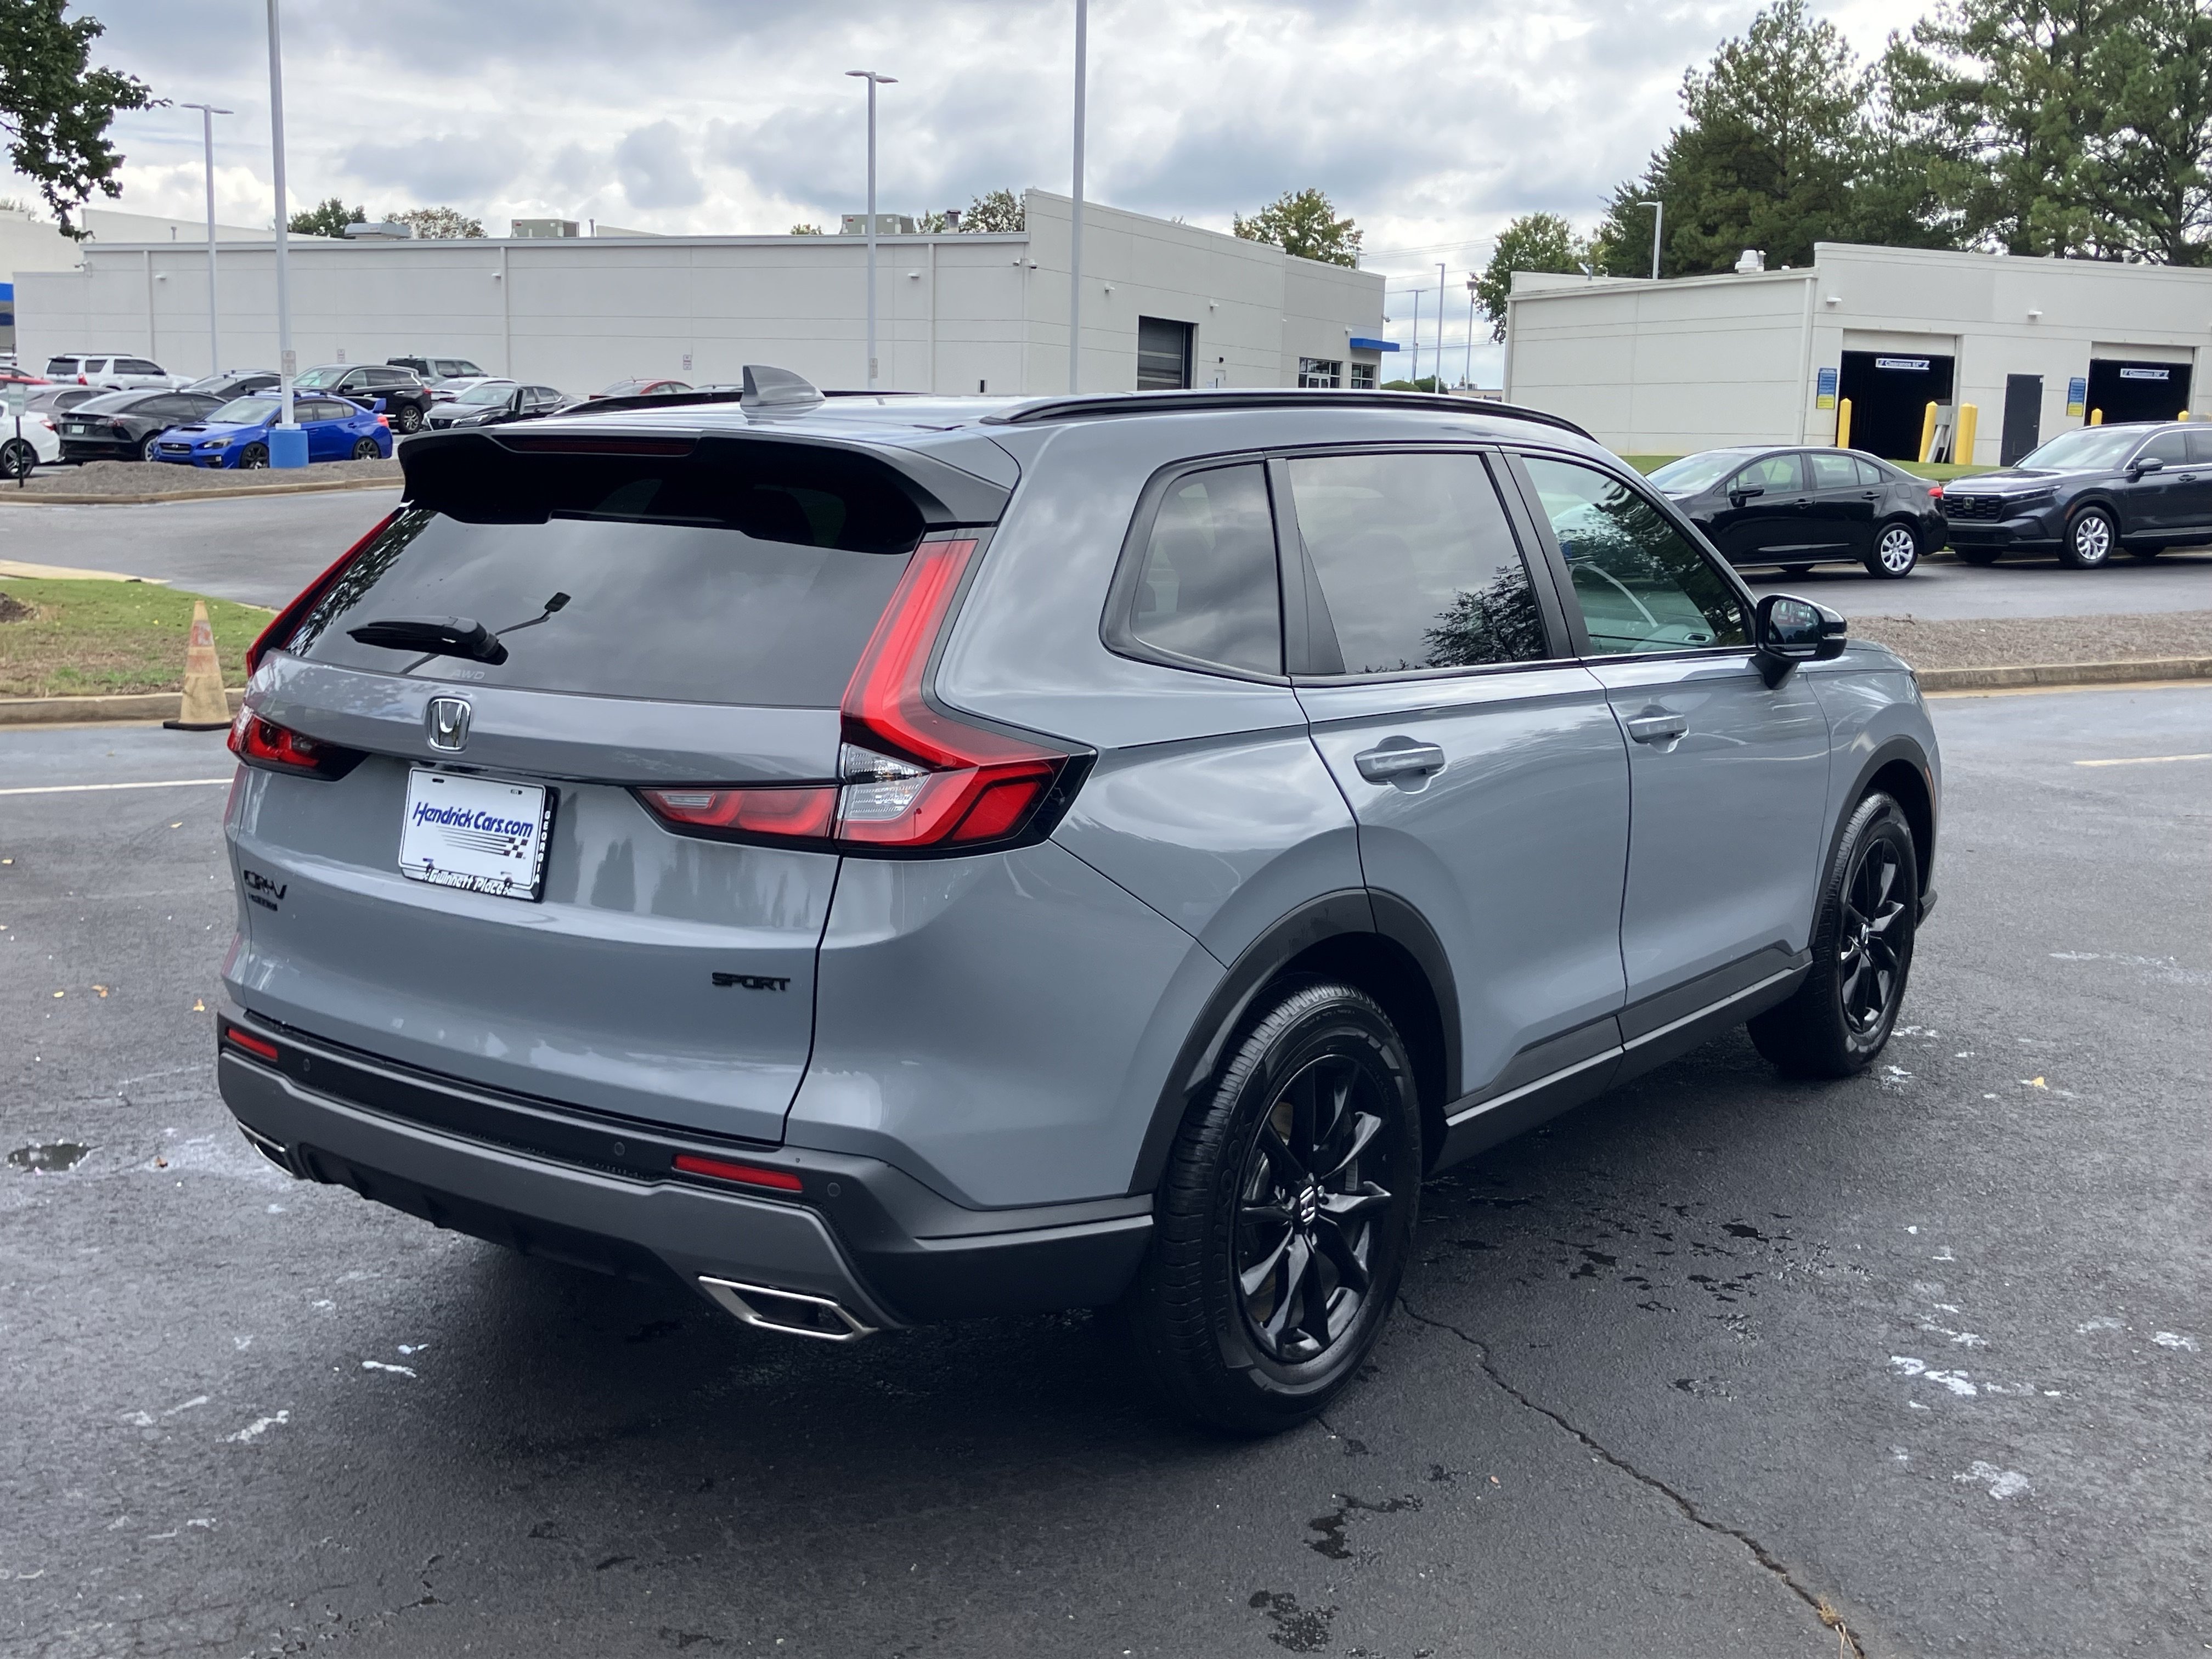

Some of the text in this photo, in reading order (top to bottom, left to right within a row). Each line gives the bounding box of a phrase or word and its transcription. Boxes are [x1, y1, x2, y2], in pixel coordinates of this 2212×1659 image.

[450, 670, 485, 680] AWD
[428, 868, 505, 895] Gwinnett Place
[712, 973, 791, 991] SPORT
